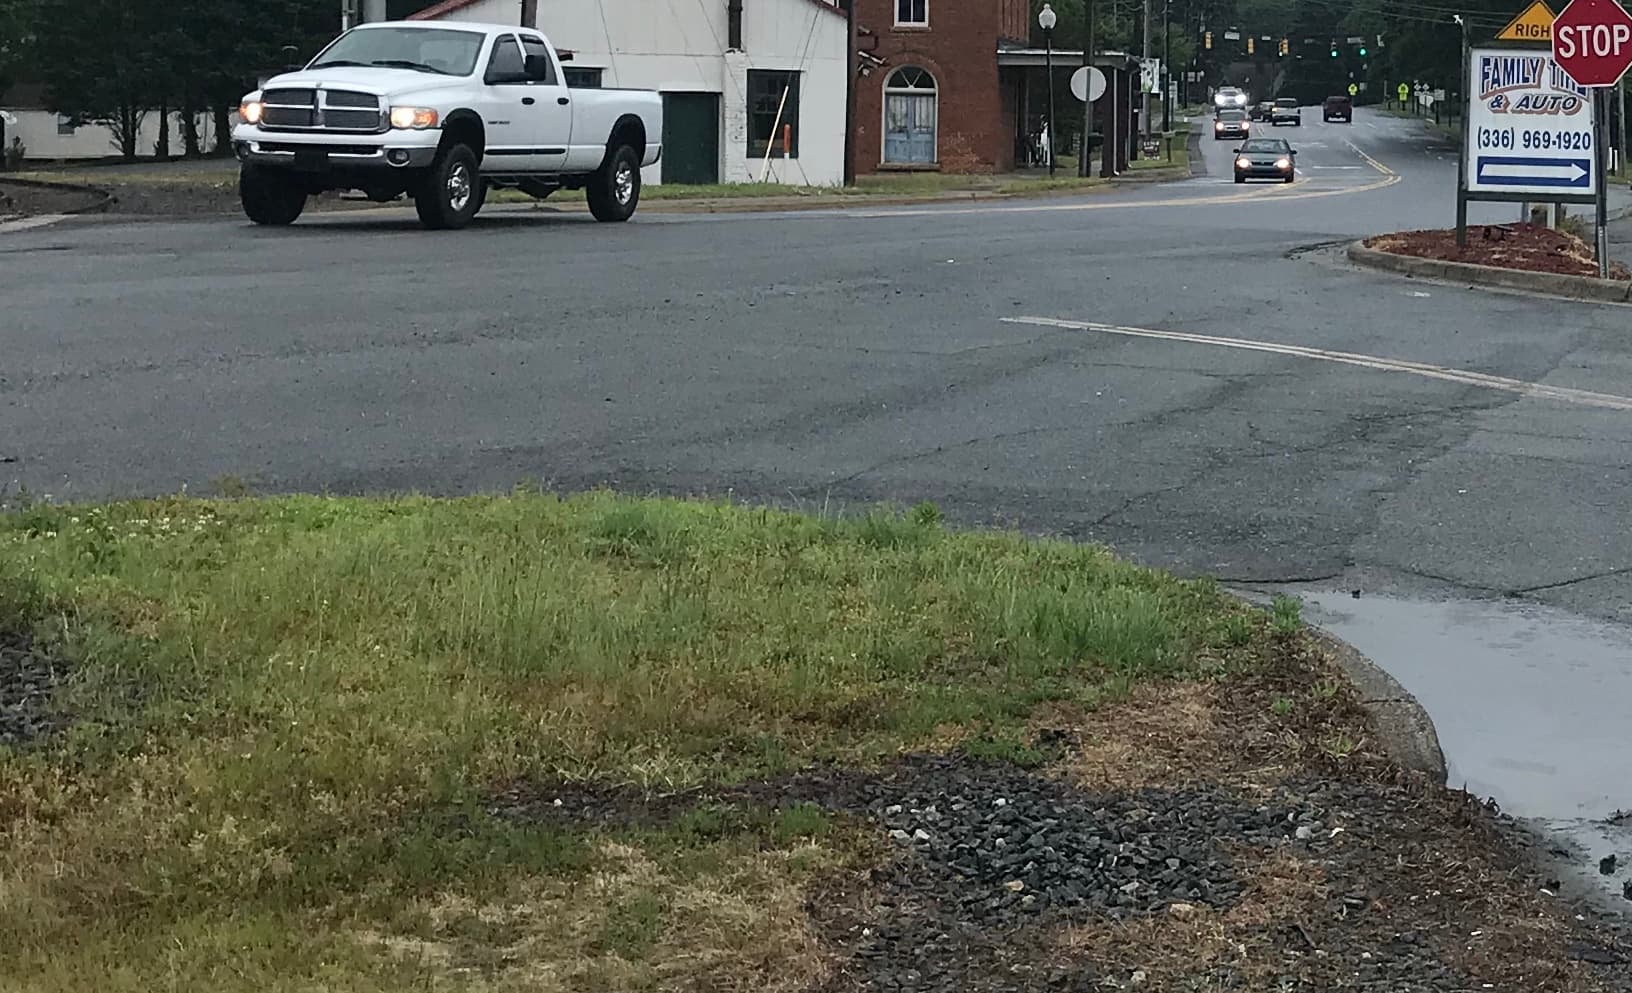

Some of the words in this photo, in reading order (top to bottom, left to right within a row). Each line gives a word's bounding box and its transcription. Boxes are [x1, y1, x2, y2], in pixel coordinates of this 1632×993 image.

[1515, 23, 1550, 38] RIGH
[1558, 24, 1630, 59] STOP
[1480, 56, 1543, 97] FAMILY
[1549, 58, 1588, 99] TI
[1488, 94, 1507, 111] &
[1514, 95, 1580, 113] AUTO
[1477, 127, 1515, 150] (336)
[1523, 130, 1591, 150] 969-1920
